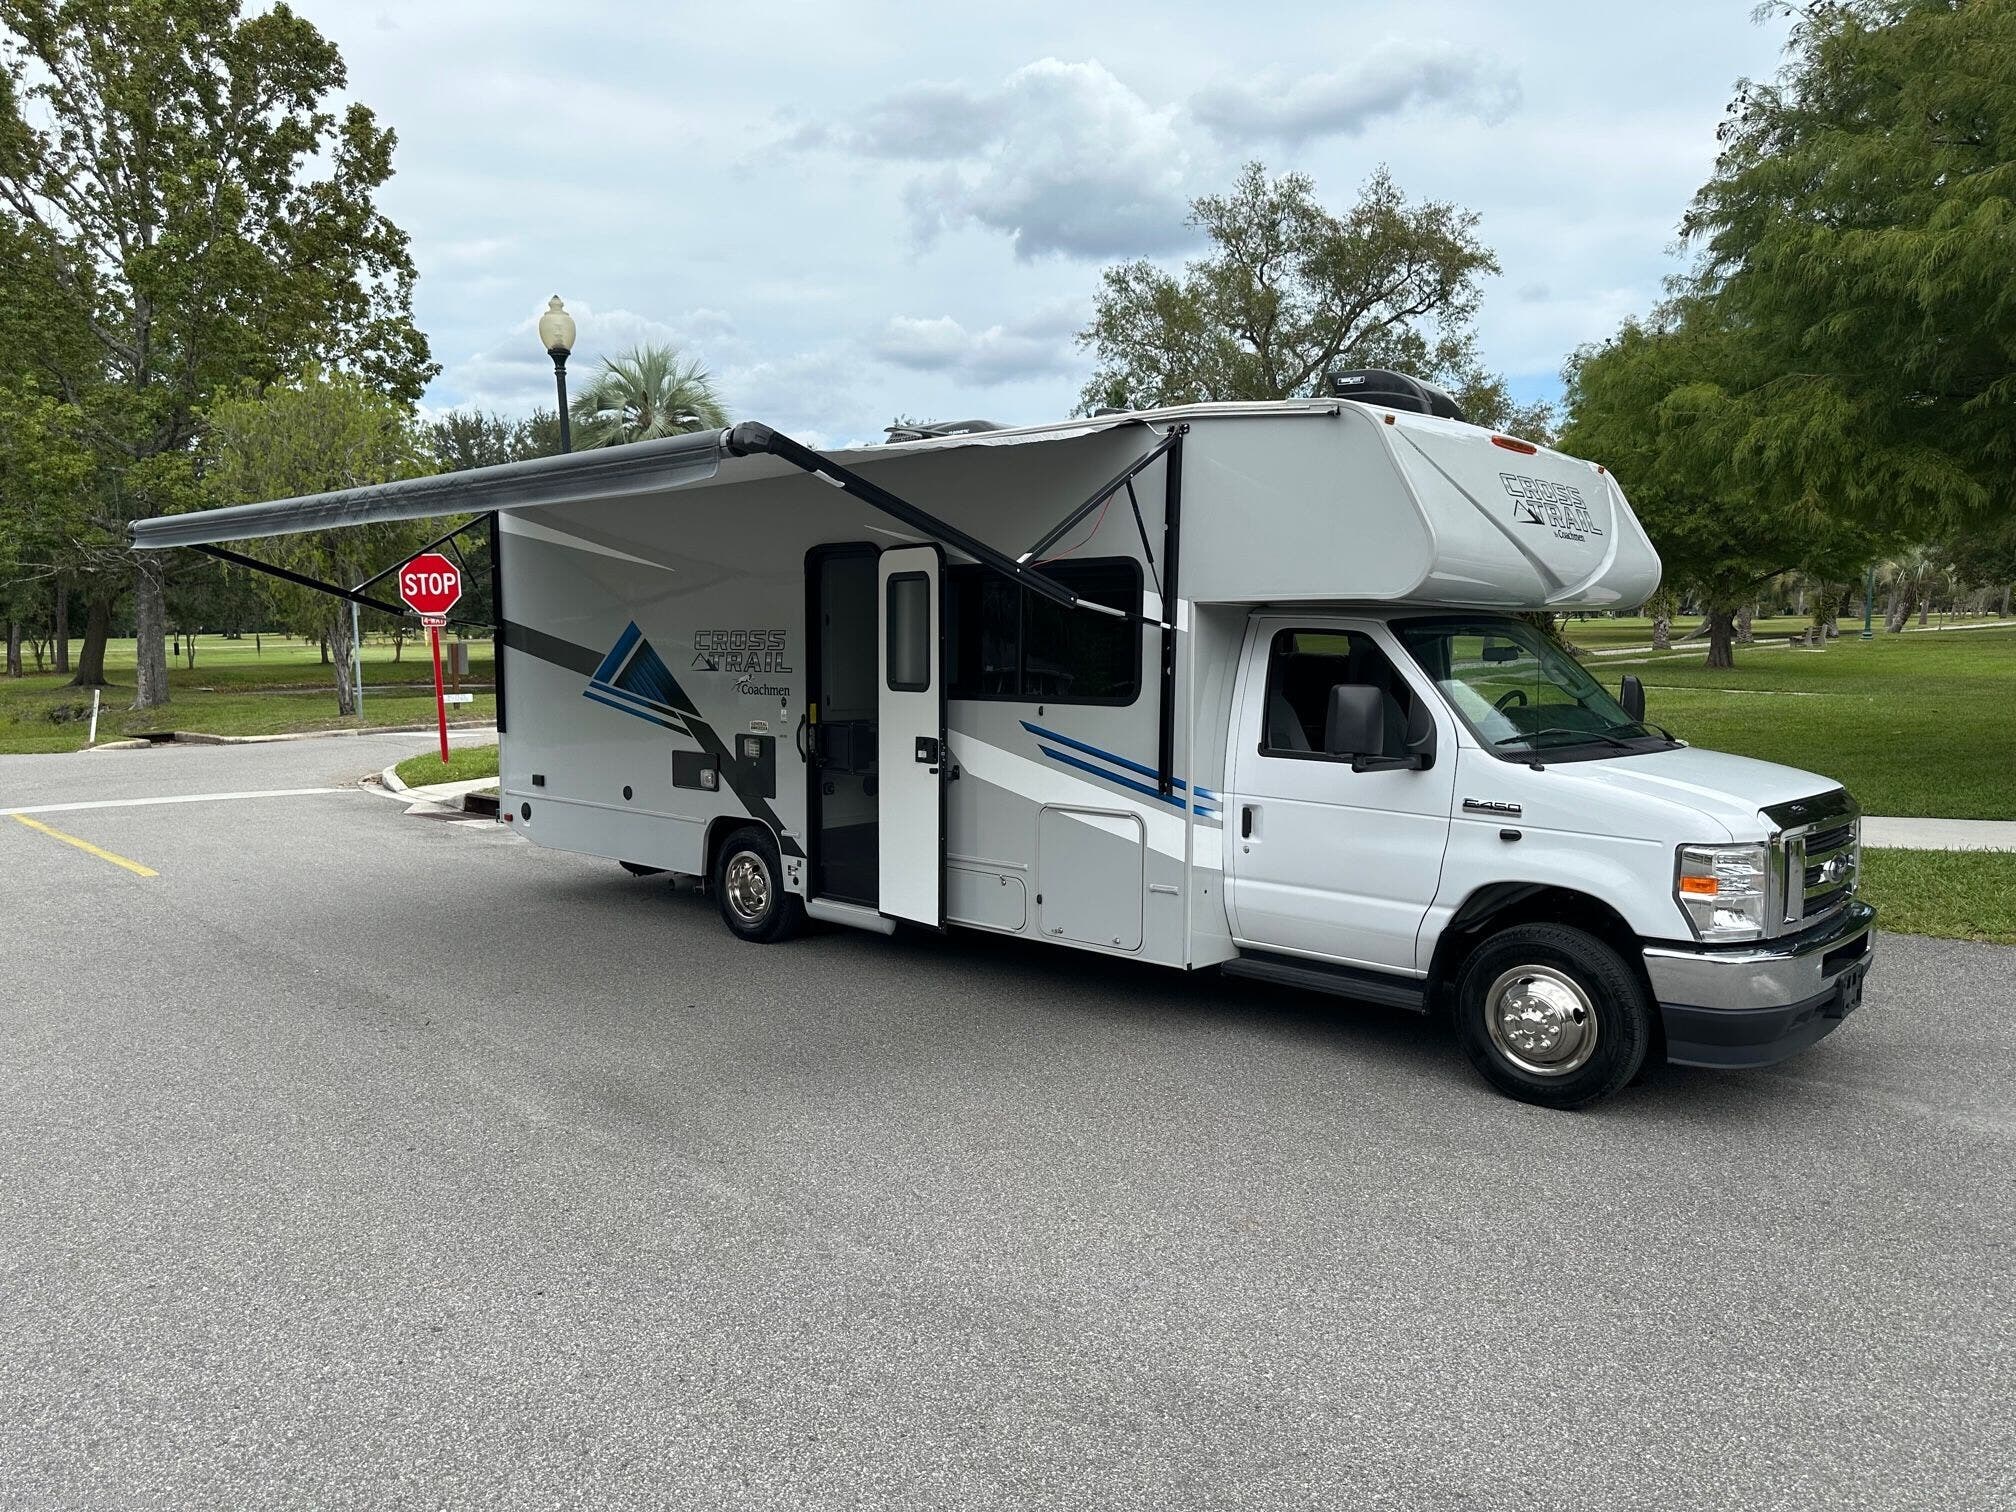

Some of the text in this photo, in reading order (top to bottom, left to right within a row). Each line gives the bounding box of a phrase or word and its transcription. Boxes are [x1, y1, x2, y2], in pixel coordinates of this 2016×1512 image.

[1499, 472, 1587, 510] CROSS
[1526, 500, 1603, 536] TRAIL
[404, 572, 457, 597] STOP
[694, 630, 787, 651] CROSS
[708, 651, 793, 673] TRAIL
[741, 684, 790, 697] Coachmen
[1463, 797, 1522, 813] E-450
